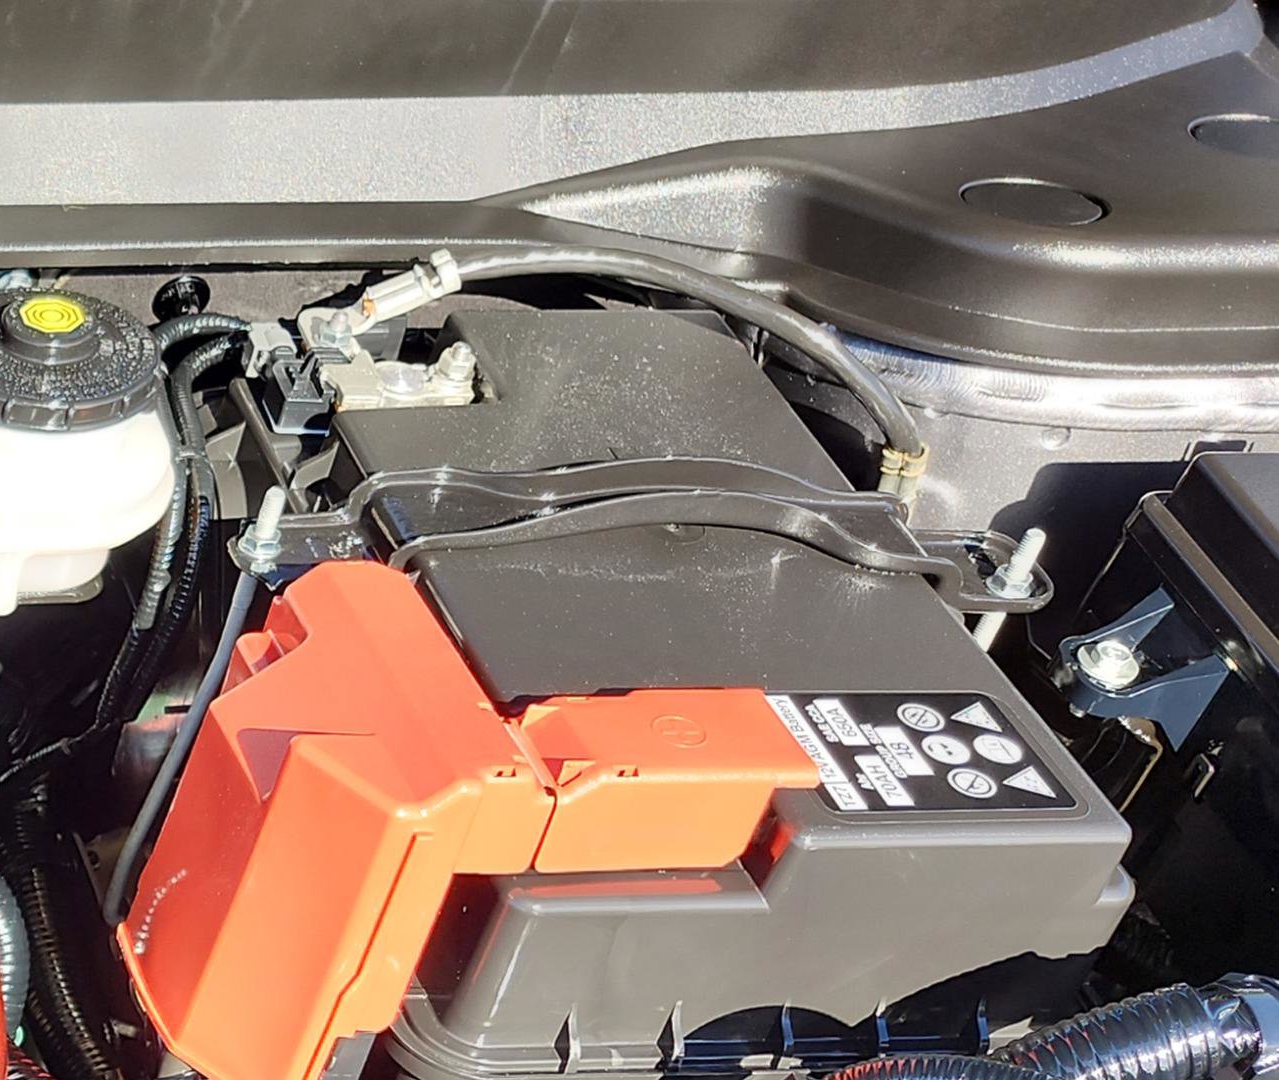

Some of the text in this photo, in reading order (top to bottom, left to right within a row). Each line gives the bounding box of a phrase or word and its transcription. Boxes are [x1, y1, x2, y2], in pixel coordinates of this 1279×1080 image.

[773, 697, 804, 732] Battery
[826, 707, 857, 738] 650A
[796, 733, 823, 760] AGM
[889, 742, 915, 760] 48
[831, 785, 857, 806] TZ7
[866, 764, 902, 798] 70AH
